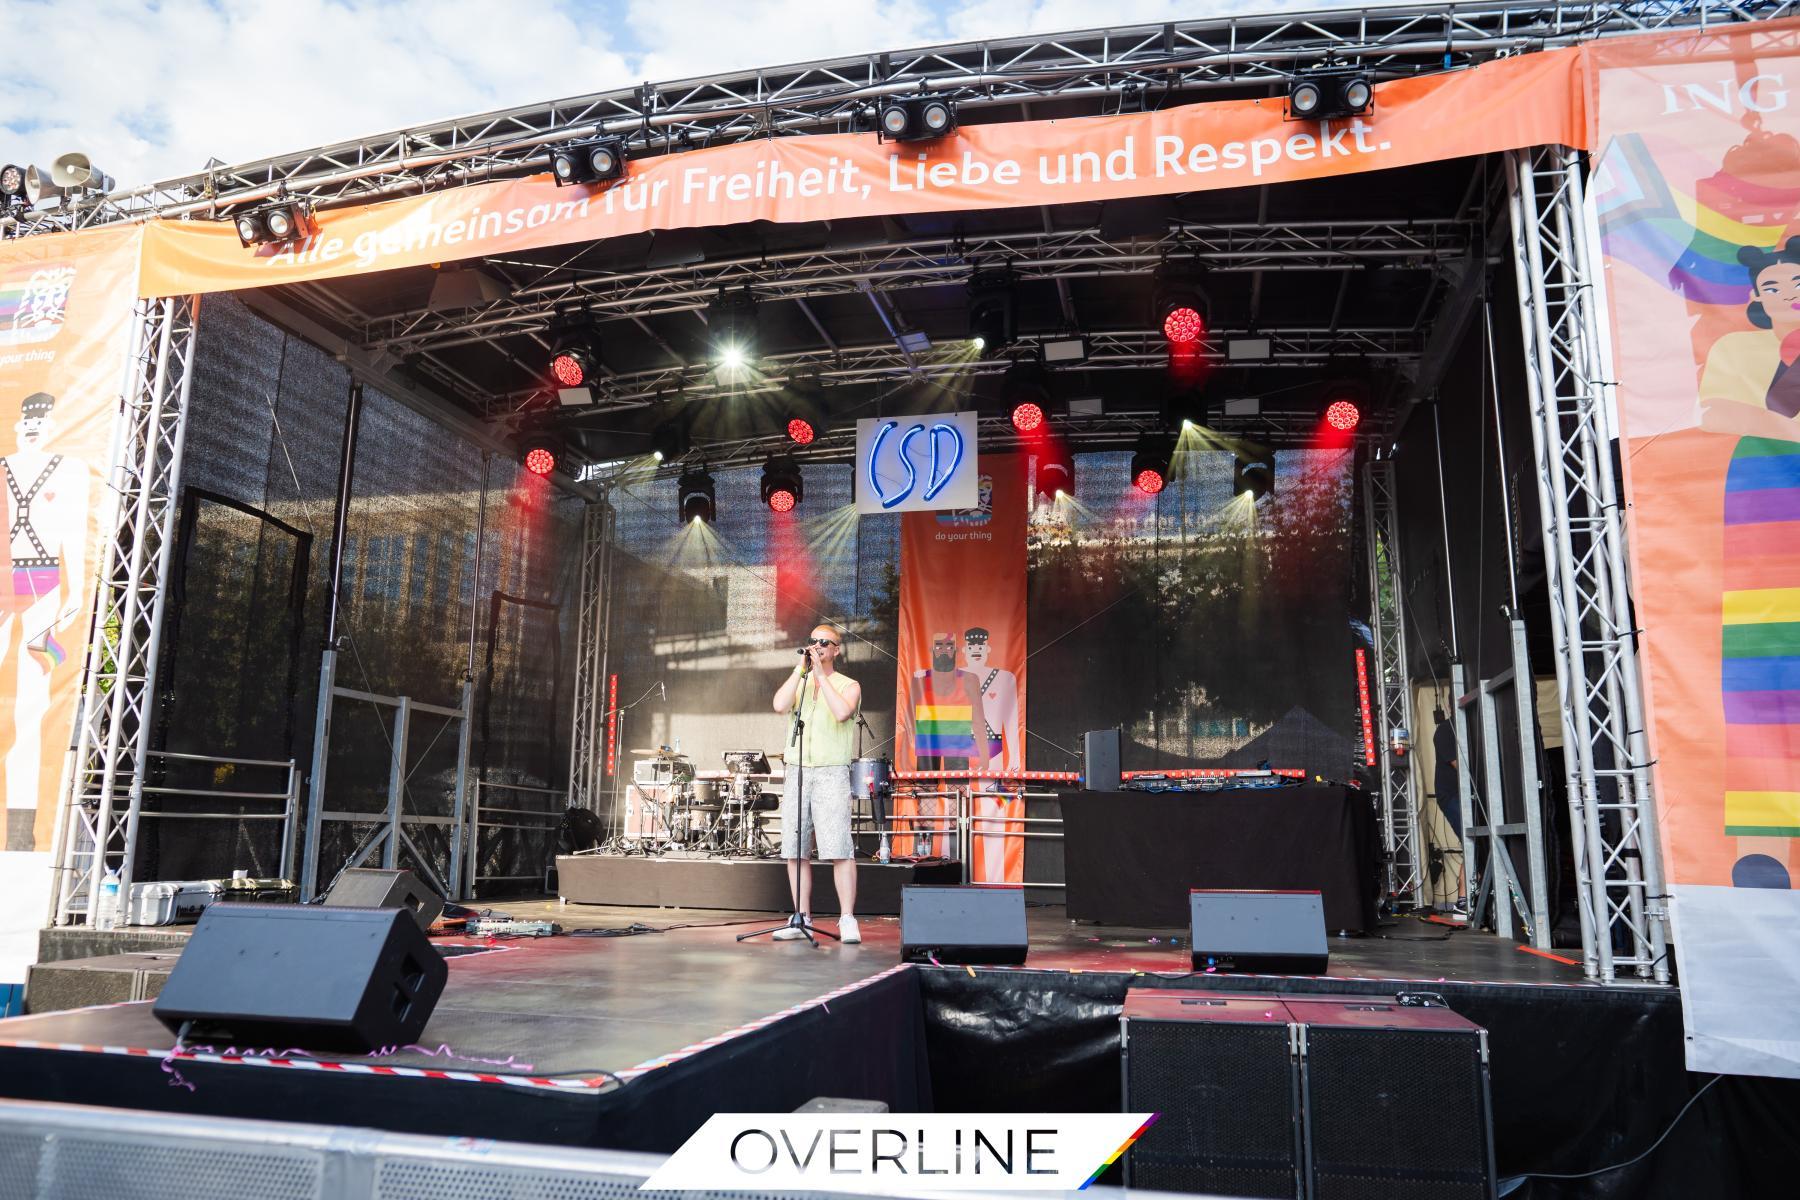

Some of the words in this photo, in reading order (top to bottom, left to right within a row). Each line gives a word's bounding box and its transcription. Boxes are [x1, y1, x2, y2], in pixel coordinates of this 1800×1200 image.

[1660, 74, 1790, 115] ING
[265, 232, 344, 266] Alle
[351, 196, 590, 268] gemeinsam
[603, 173, 669, 215] für
[682, 156, 872, 205] Freiheit,
[888, 151, 1022, 192] Liebe
[1039, 135, 1137, 184] und
[1154, 119, 1392, 177] Respekt.
[25, 348, 56, 363] thing
[868, 421, 964, 509] CSD
[935, 531, 946, 540] do
[947, 532, 968, 542] your
[969, 530, 992, 541] thing
